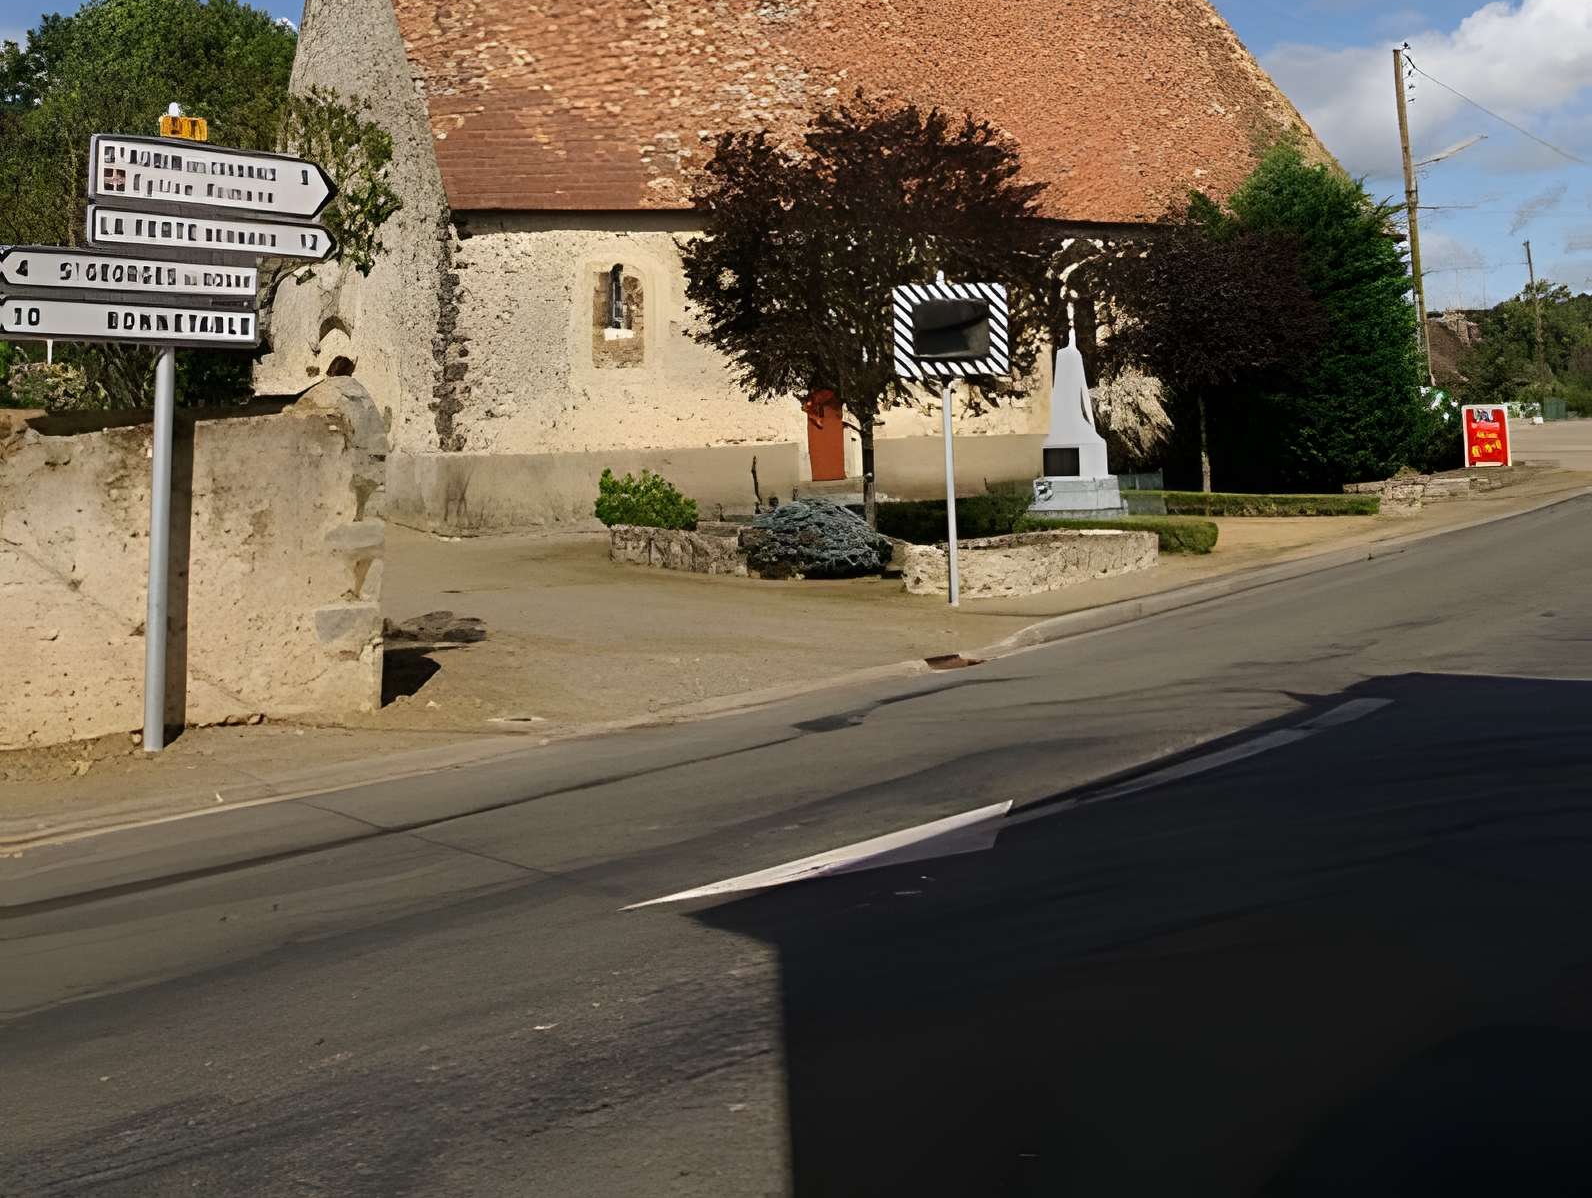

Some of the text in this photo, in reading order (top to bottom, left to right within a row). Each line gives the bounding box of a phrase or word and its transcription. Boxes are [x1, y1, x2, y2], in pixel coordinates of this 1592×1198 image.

[16, 259, 29, 277] 4
[85, 263, 177, 286] GEORGES
[14, 307, 251, 335] 10 BONNETABLE
